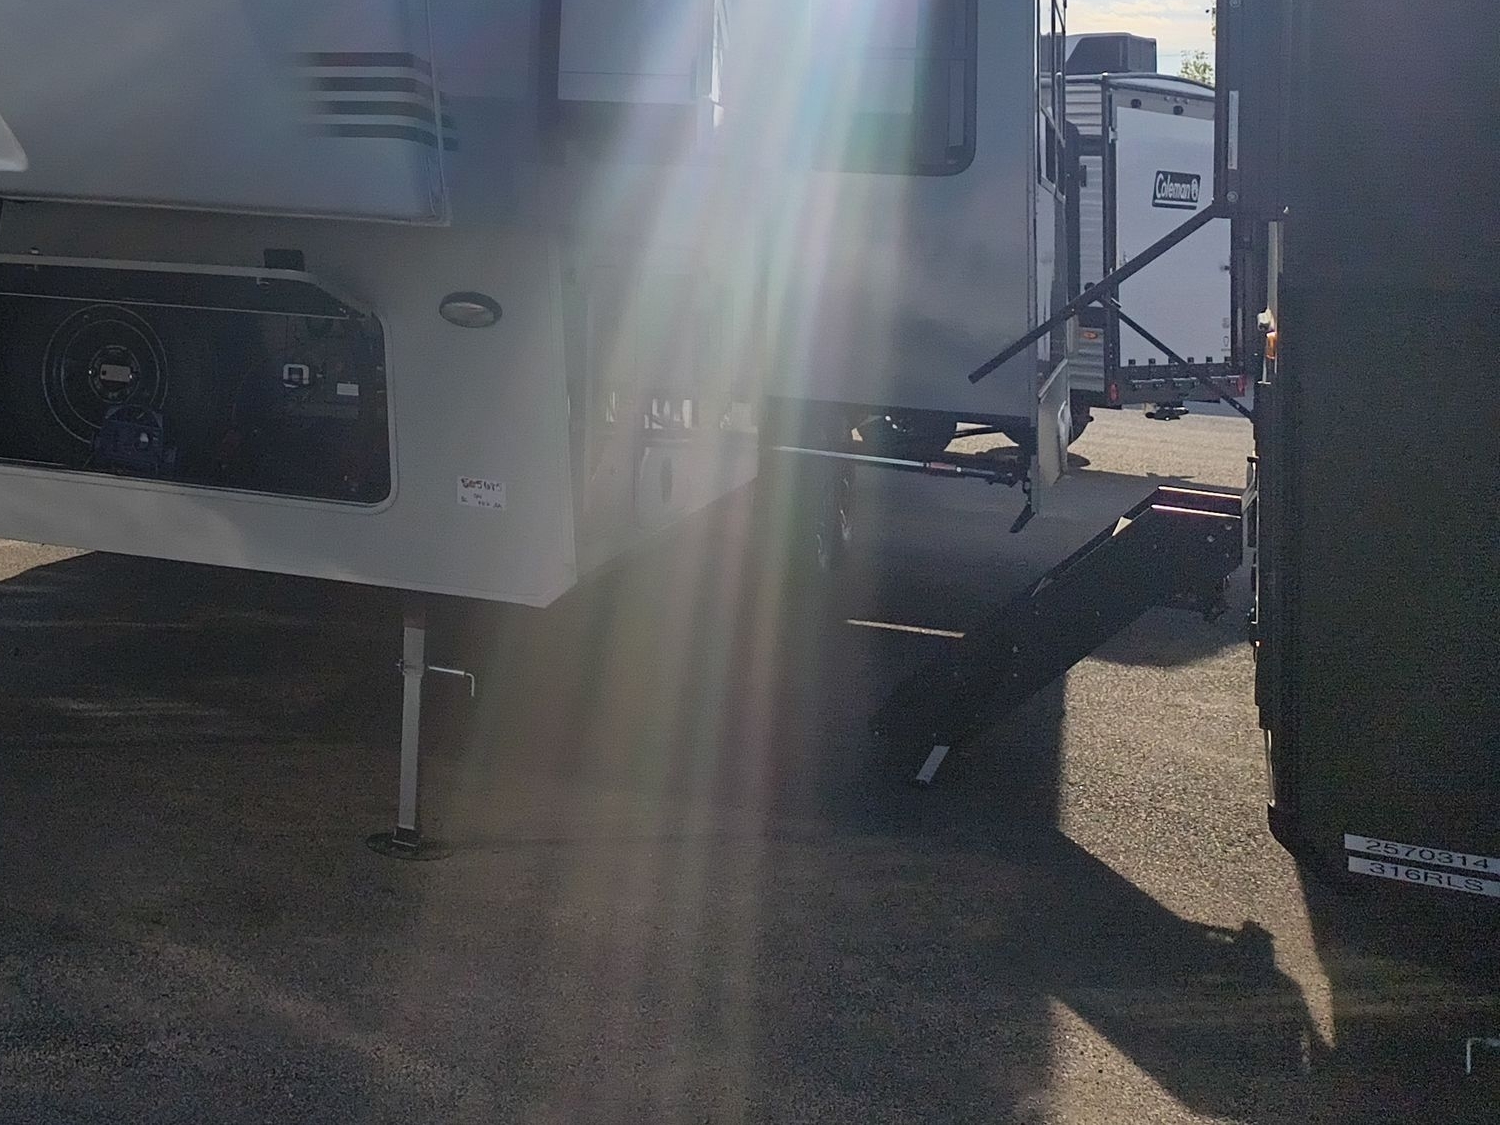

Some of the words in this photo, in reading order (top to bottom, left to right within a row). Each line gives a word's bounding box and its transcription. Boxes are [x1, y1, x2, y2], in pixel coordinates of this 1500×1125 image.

[1155, 172, 1191, 200] Coleman
[1365, 839, 1489, 869] 2570314
[1369, 862, 1485, 892] 316RLS
